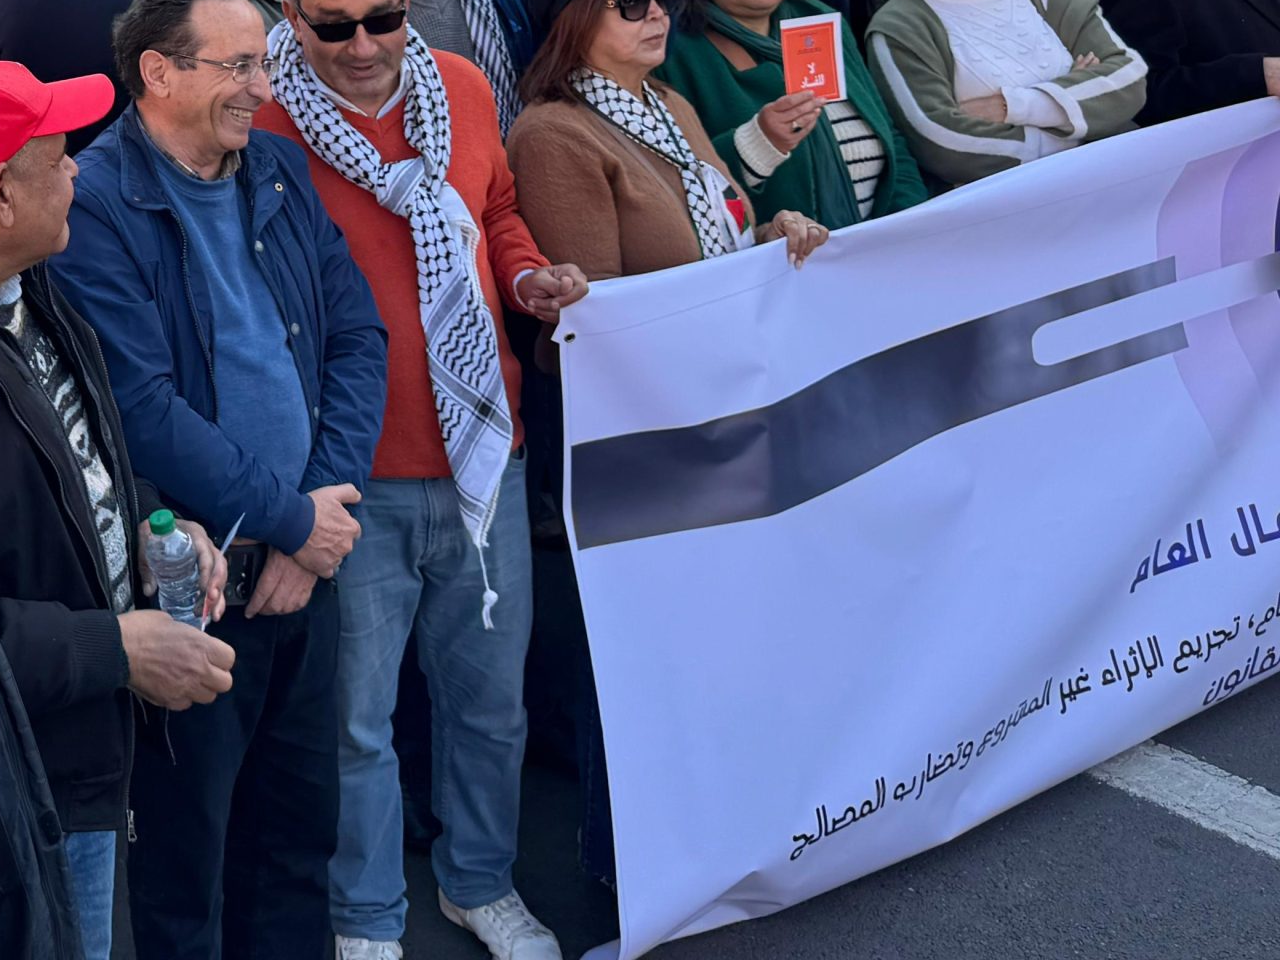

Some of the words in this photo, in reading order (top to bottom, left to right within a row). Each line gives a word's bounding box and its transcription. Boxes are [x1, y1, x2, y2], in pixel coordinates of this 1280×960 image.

[1129, 518, 1212, 594] العام
[1230, 503, 1280, 557] ال
[1101, 634, 1165, 692] الإثراء
[1173, 615, 1241, 673] تجريم
[1058, 667, 1092, 715] غير
[1202, 645, 1280, 707] قانون
[976, 676, 1054, 758] المشروع
[893, 740, 974, 802] وتضارب
[789, 776, 887, 862] المصالح
